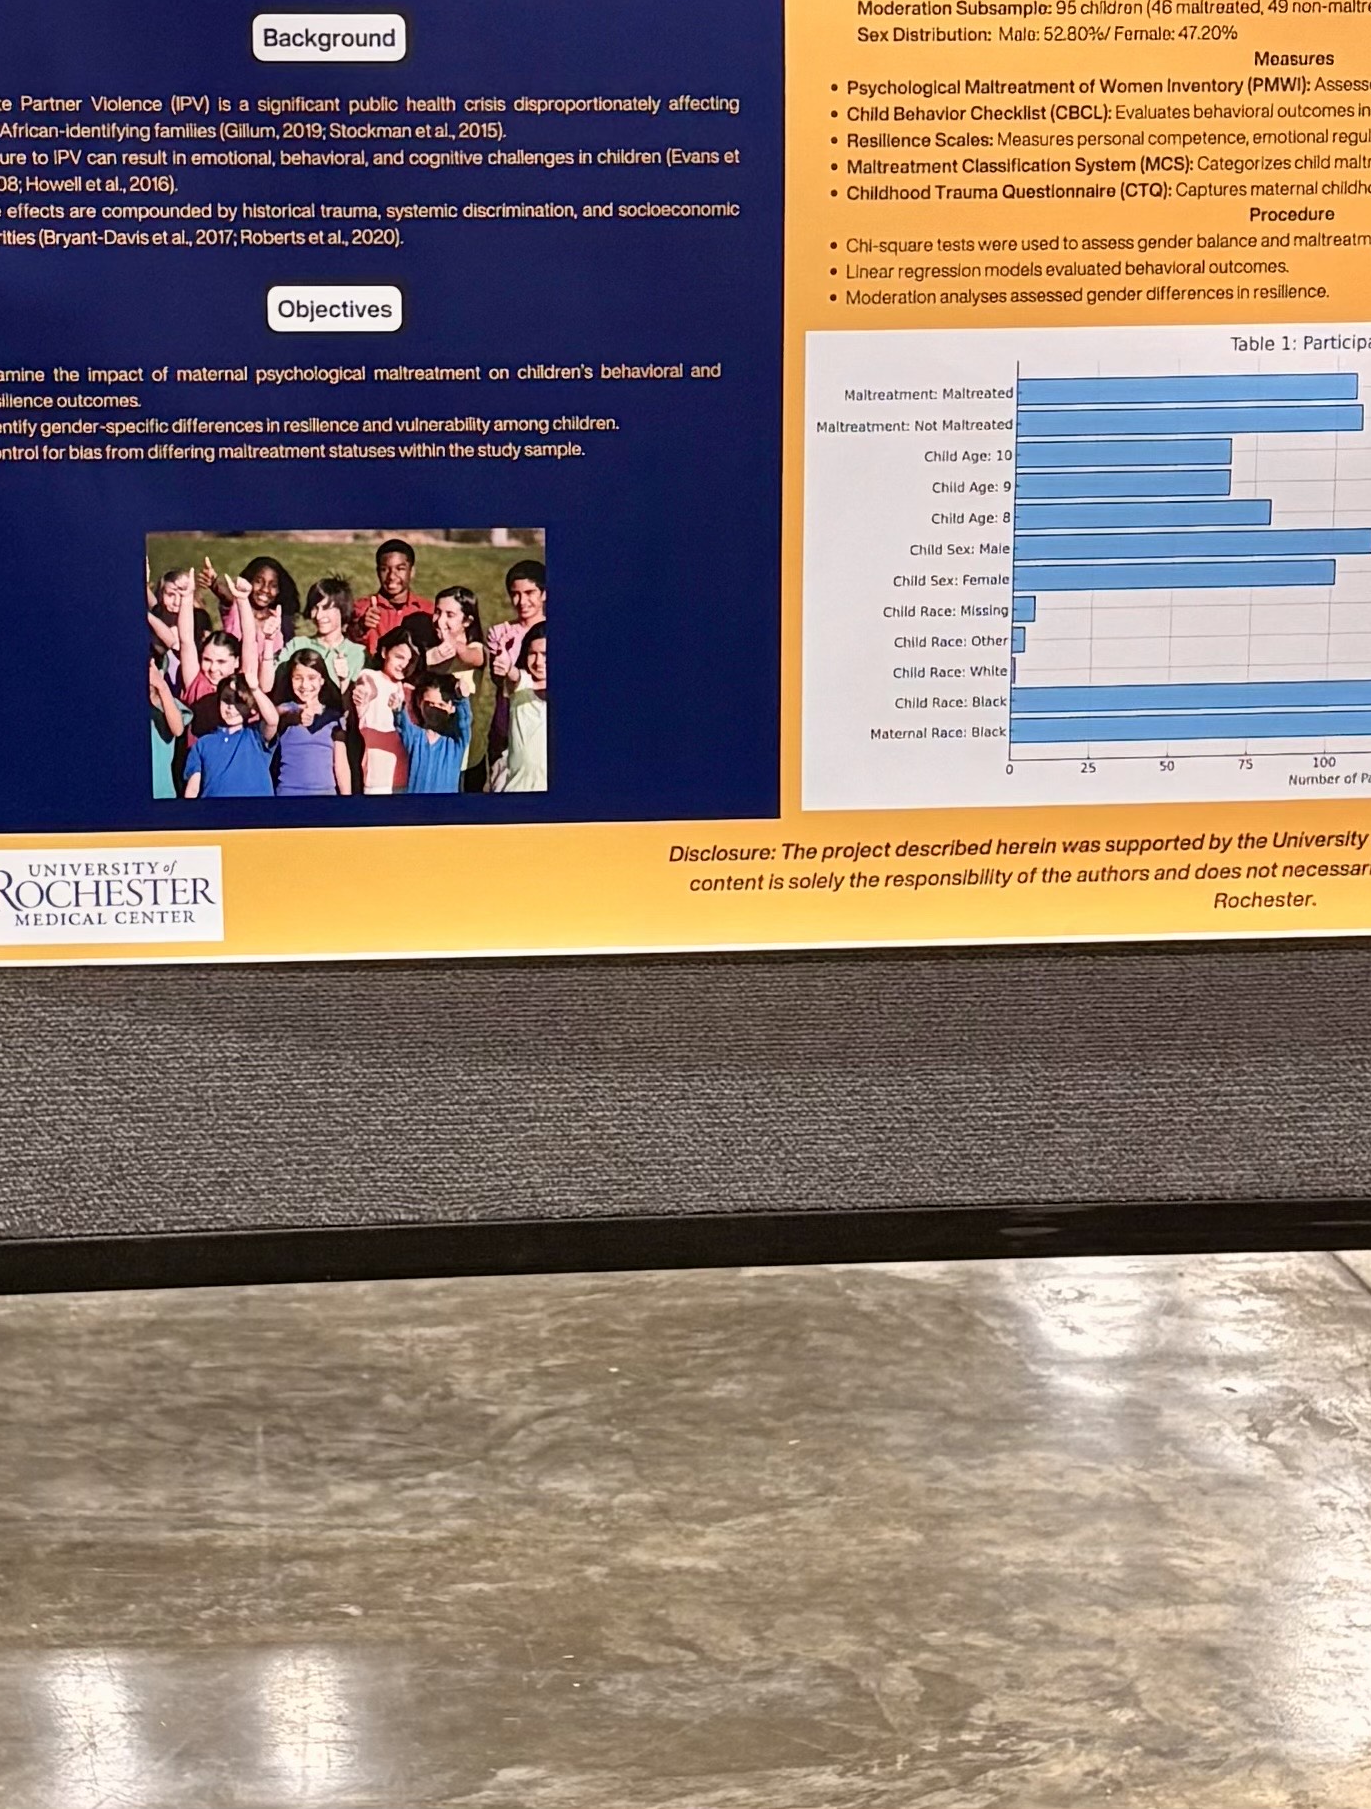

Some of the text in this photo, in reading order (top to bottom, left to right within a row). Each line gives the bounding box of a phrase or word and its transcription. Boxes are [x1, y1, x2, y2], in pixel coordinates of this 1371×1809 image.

[263, 27, 395, 52] Background
[1254, 50, 1334, 65] Measures
[1249, 206, 1335, 221] Procedure
[277, 299, 392, 322] Objectives
[1229, 335, 1274, 351] Table
[1281, 335, 1296, 350] 1:
[844, 386, 1013, 401] Maltreatment: Maltreated
[924, 449, 1012, 464] Child Age: 10
[1080, 762, 1096, 773] 25
[1159, 760, 1174, 771] 50
[1238, 757, 1253, 769] 75
[1313, 756, 1336, 768] 100
[28, 860, 178, 877] UNIVERSITY of
[15, 910, 195, 927] MEDICAL CENTER
